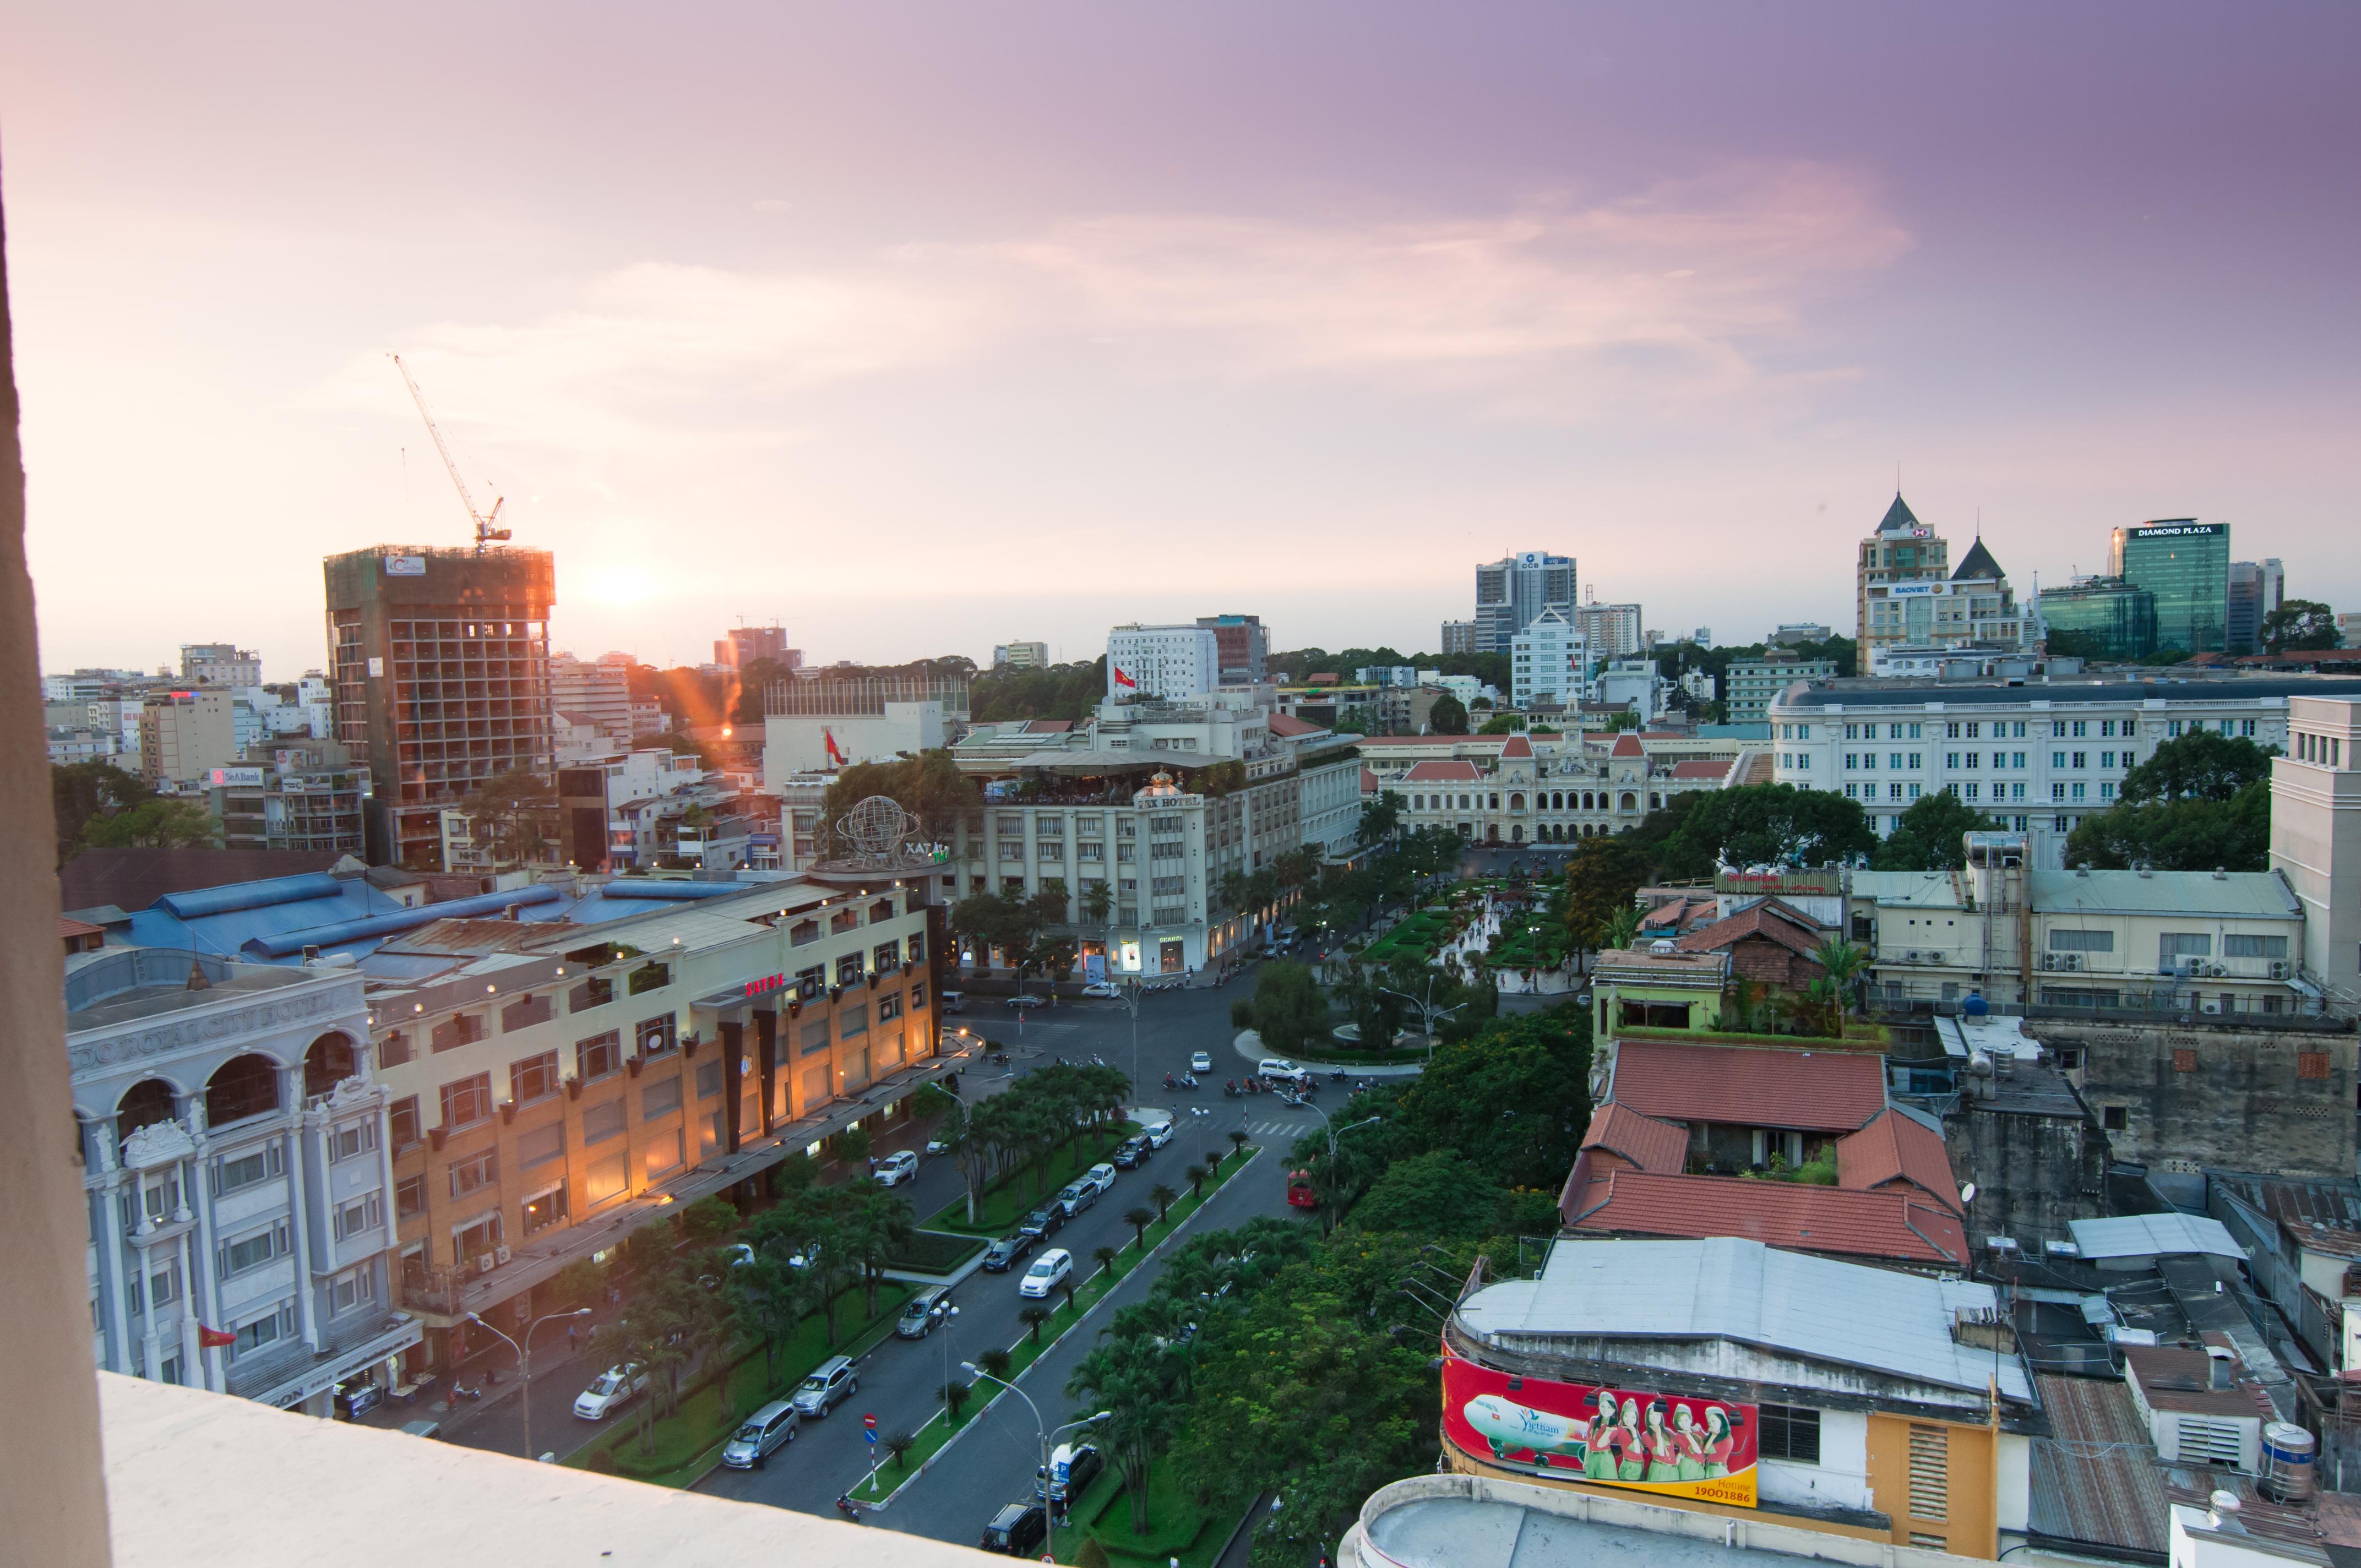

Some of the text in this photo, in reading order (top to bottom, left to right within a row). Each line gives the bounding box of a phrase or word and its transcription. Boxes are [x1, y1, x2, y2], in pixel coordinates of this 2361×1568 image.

[225, 772, 260, 781] SeABank
[1162, 797, 1200, 807] HOTEL
[746, 973, 784, 996] SATRA
[119, 1023, 203, 1059] ROYAL
[206, 1009, 257, 1037] CITY
[259, 993, 331, 1026] HOTEL
[1517, 1412, 1559, 1434] Vietnam
[1718, 1479, 1750, 1492] Hotline
[1695, 1487, 1750, 1502] 19001886
